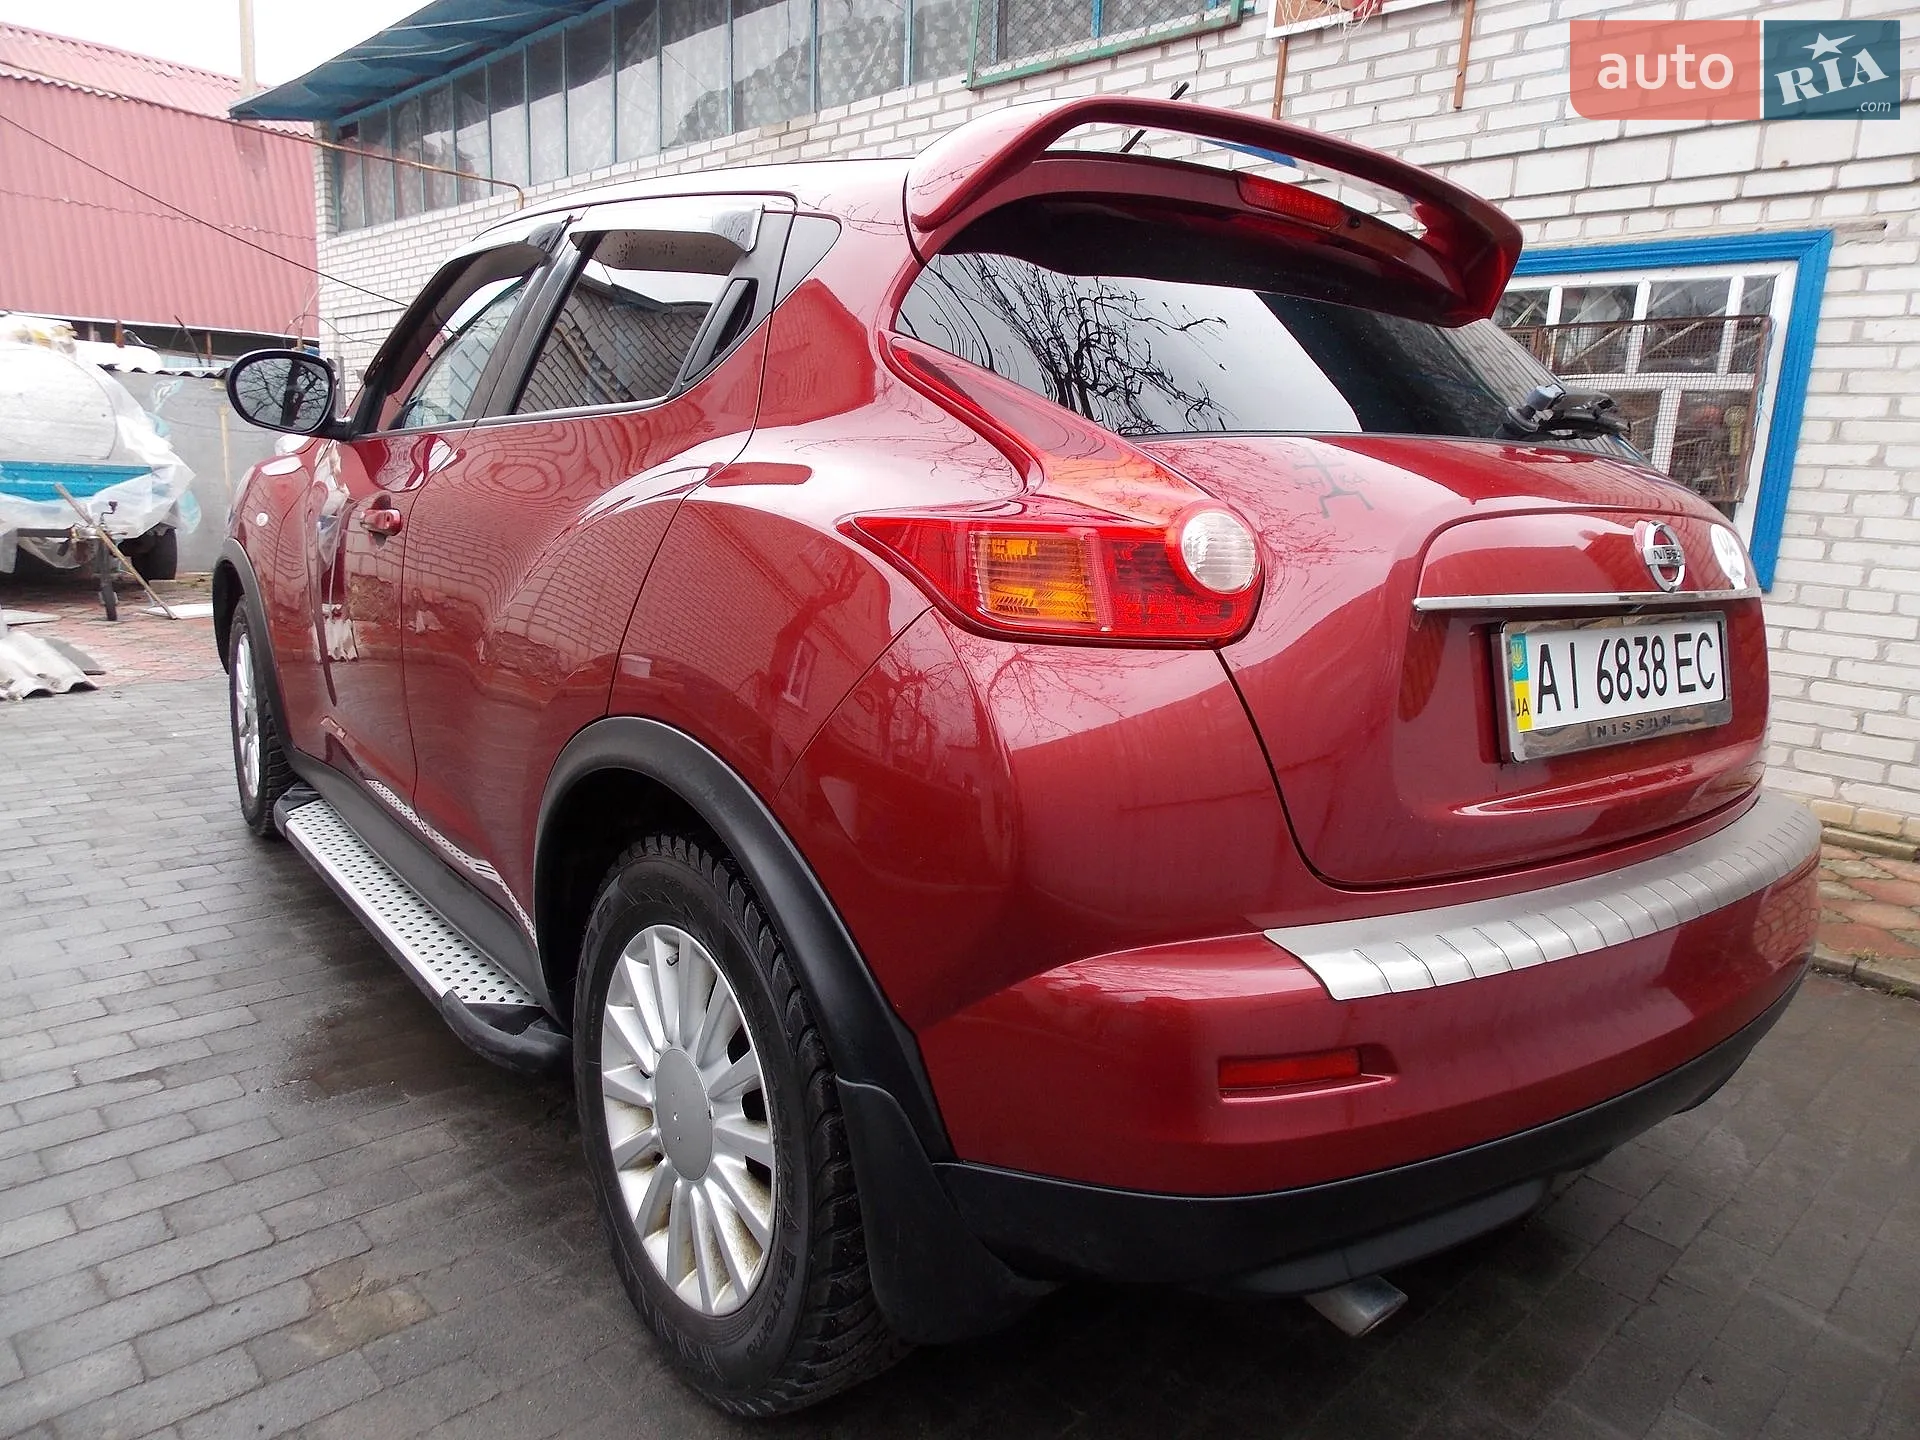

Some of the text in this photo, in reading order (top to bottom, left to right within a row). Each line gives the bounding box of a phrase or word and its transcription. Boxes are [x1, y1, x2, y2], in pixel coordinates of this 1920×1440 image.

[1537, 632, 1717, 714] AI 6838 EC
[1597, 714, 1671, 738] NISSAN
